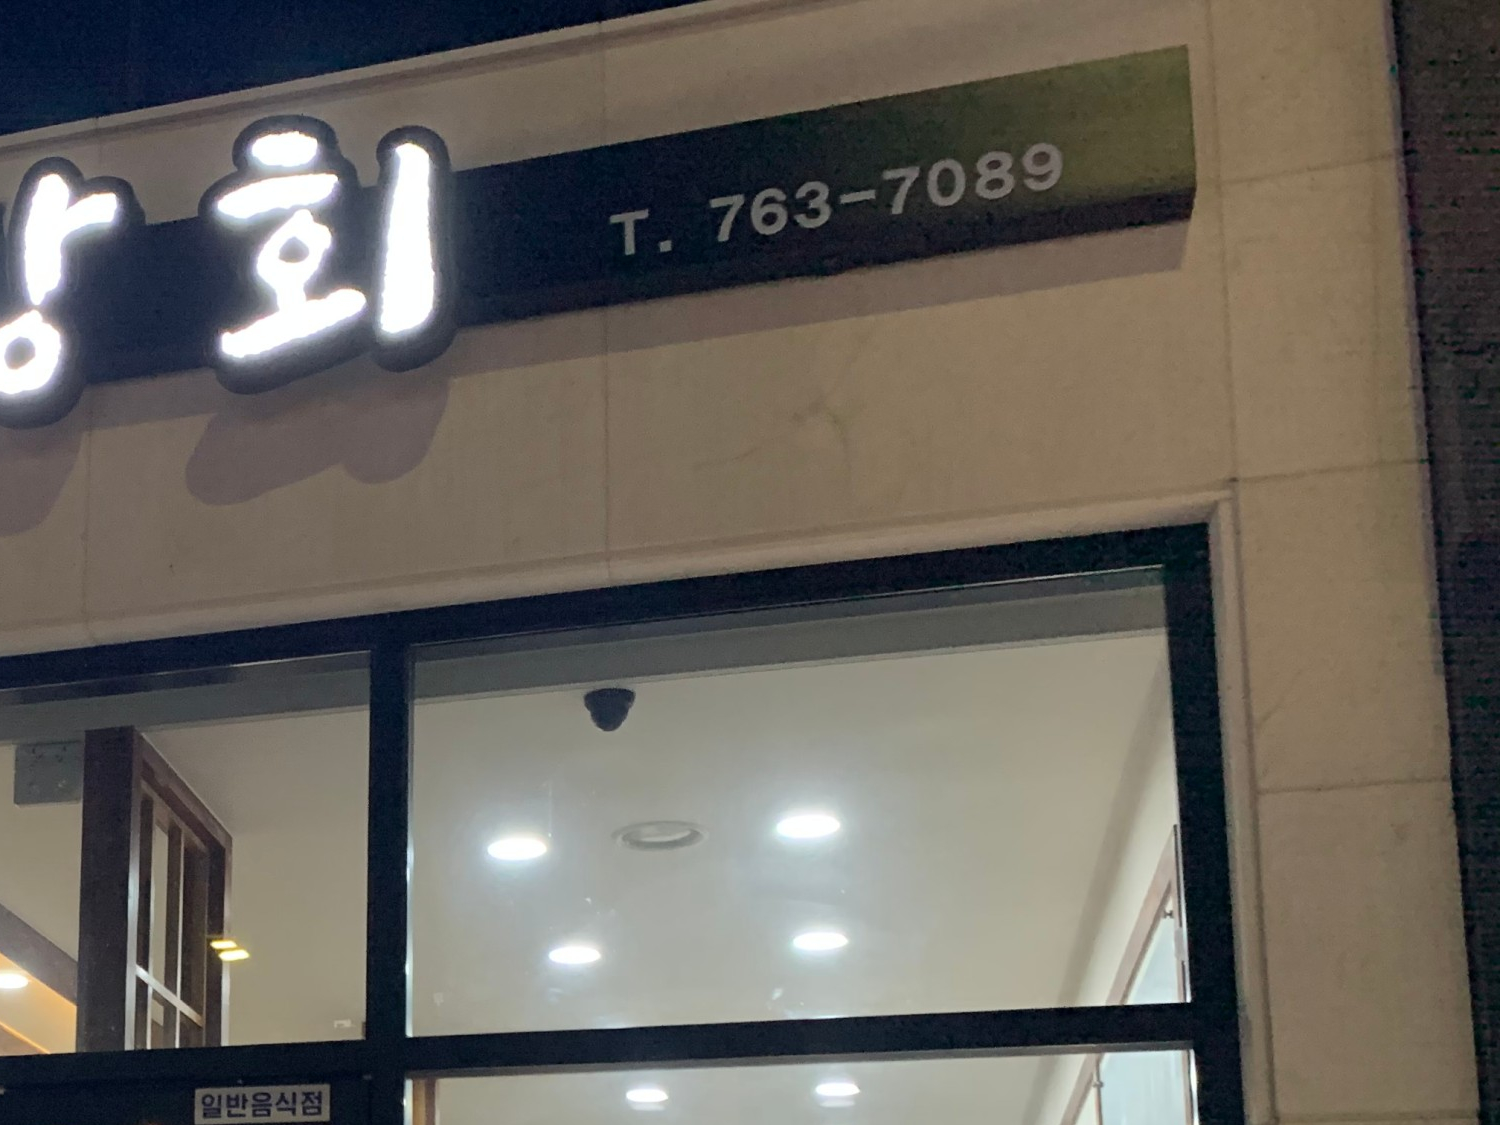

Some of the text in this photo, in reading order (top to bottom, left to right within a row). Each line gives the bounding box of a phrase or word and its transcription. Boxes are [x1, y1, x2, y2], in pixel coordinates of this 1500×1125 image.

[610, 142, 1064, 256] T. 763-7089
[201, 1090, 323, 1119] 일반음식점
